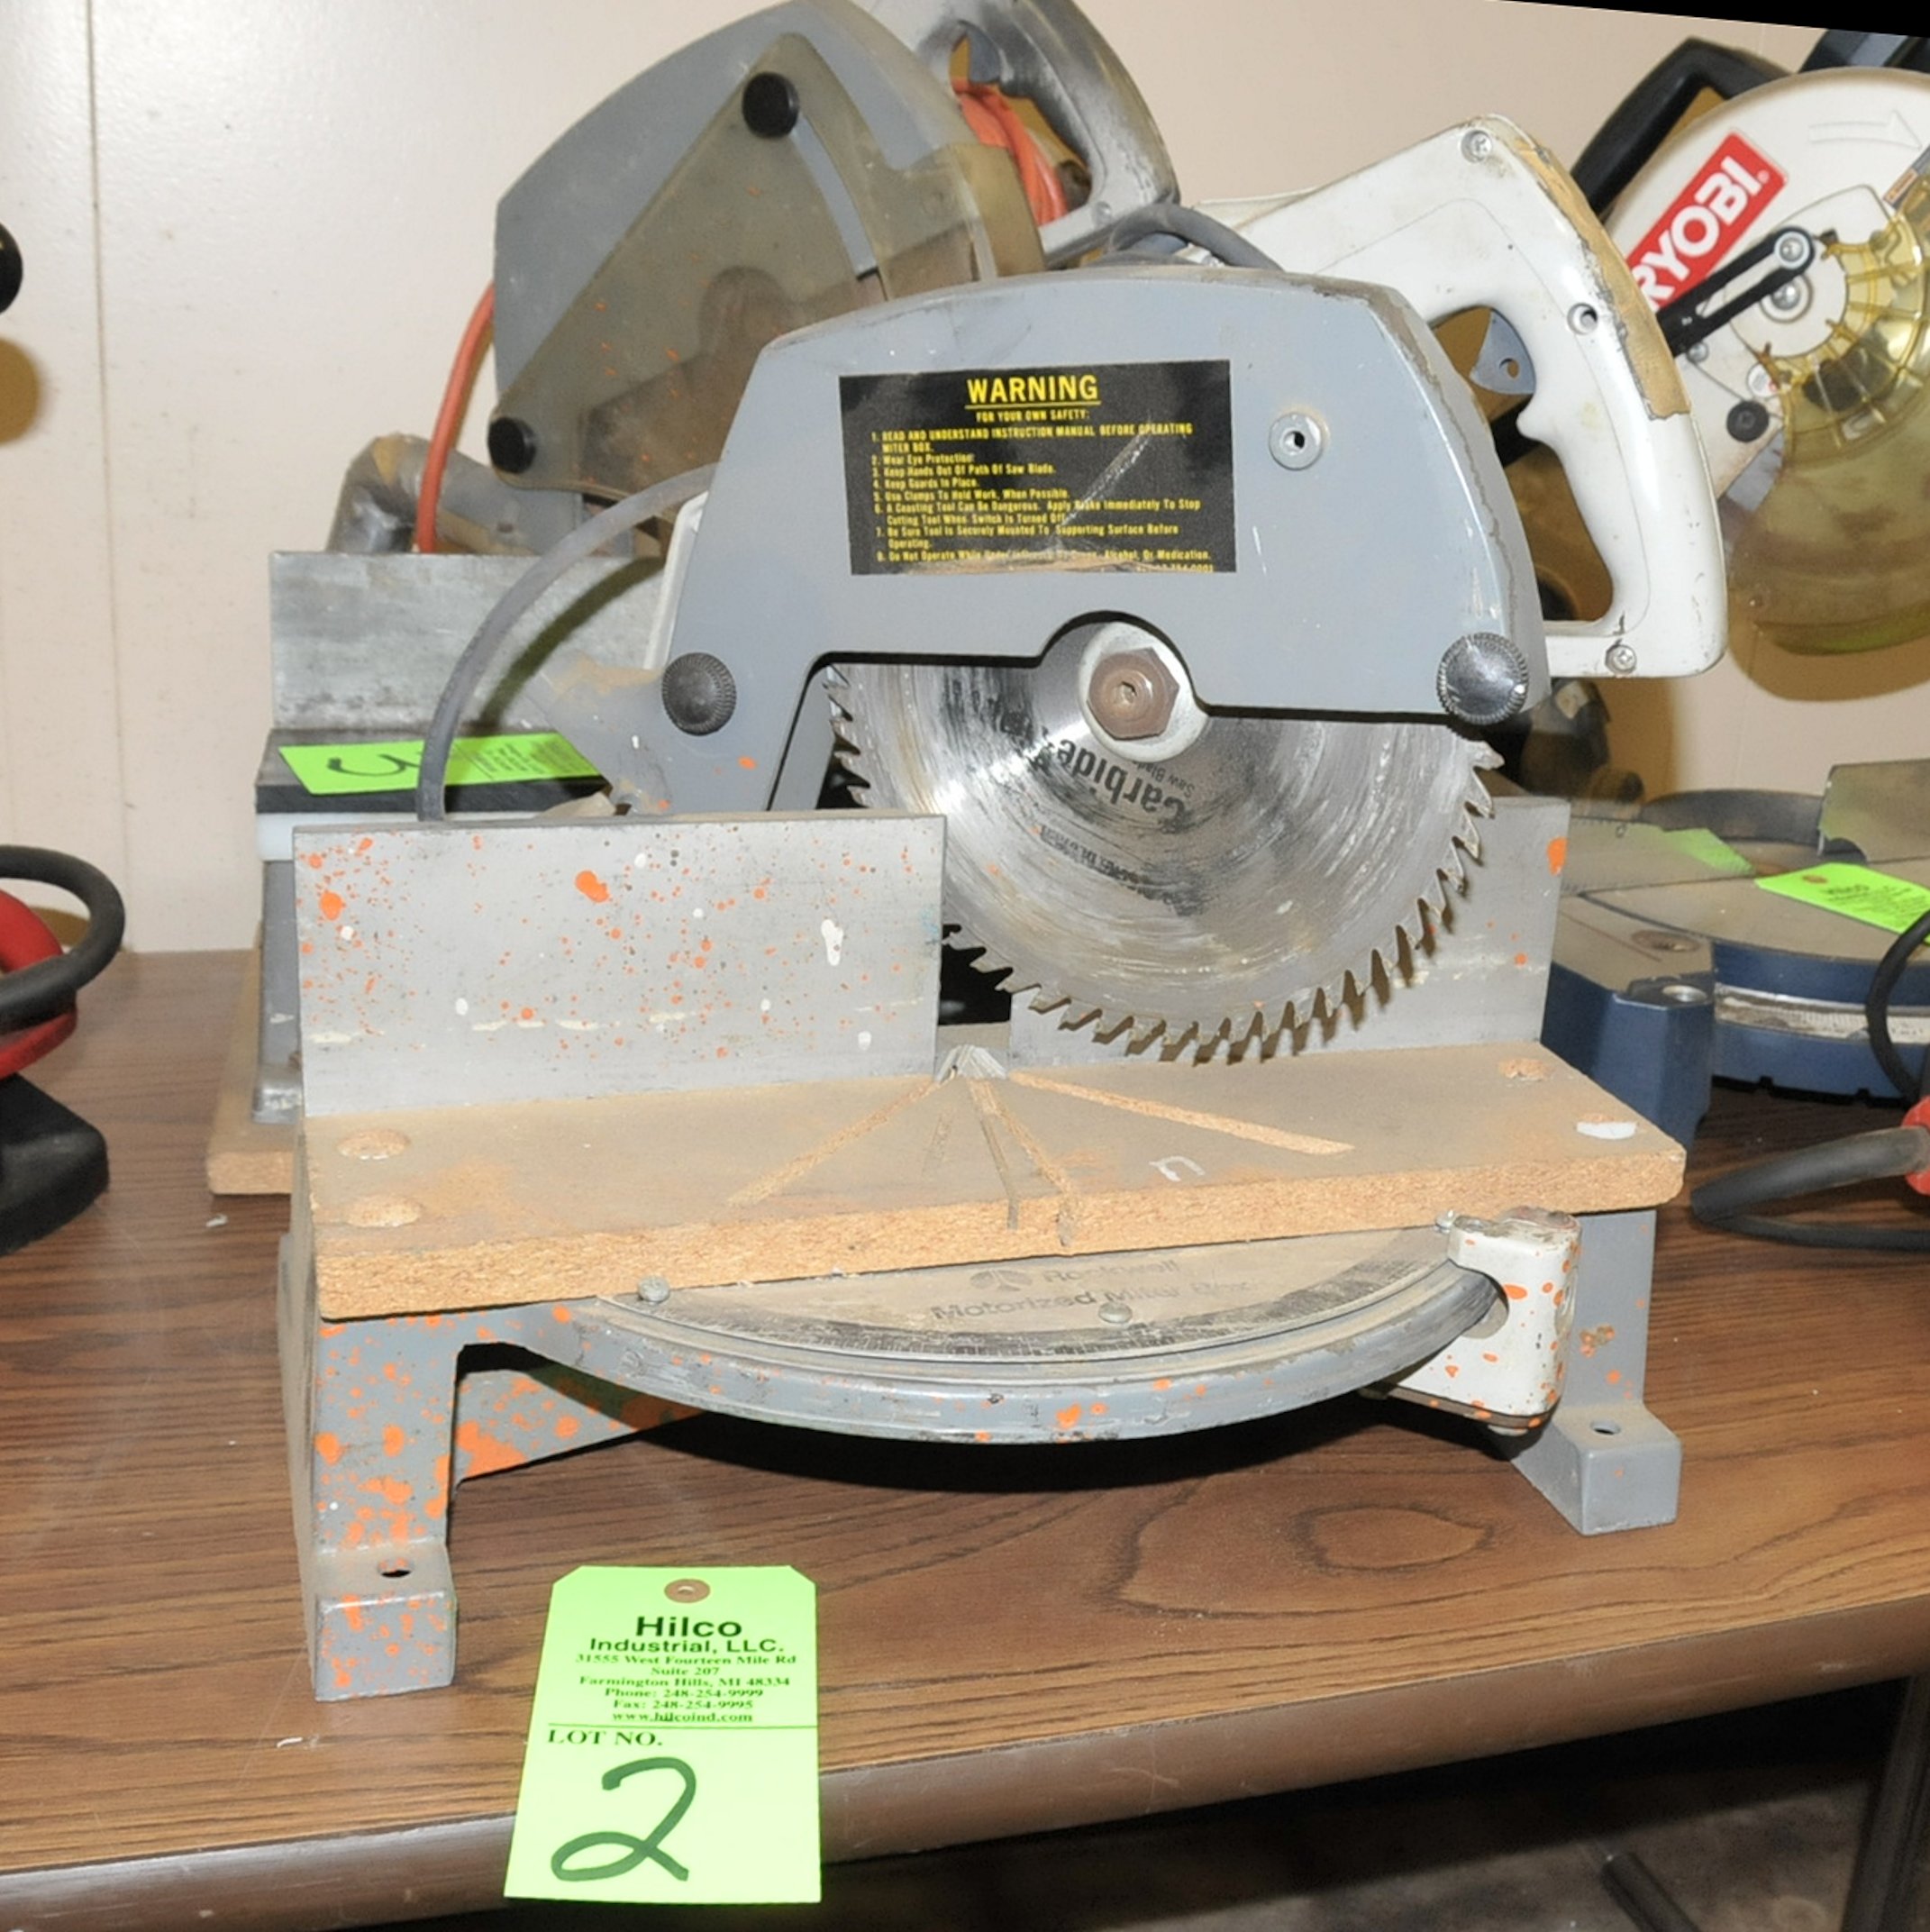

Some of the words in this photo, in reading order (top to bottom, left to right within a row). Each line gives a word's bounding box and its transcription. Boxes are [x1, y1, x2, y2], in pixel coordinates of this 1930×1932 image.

[967, 375, 1097, 403] WARNING
[976, 412, 994, 423] FOR
[997, 411, 1022, 422] YOUR
[1025, 410, 1047, 421] OWN
[882, 430, 906, 442] READ
[908, 430, 926, 441] AND
[929, 428, 989, 441] UNDERSTAND
[992, 425, 1053, 438] INSTRUCTION
[1055, 425, 1096, 436] MANUAL
[1099, 424, 1135, 436] BEFORE
[1138, 423, 1193, 434] OPERATING
[882, 442, 910, 453] MITER
[883, 454, 904, 465] Wear
[907, 454, 923, 466] Eye
[884, 466, 906, 478] Keep
[907, 466, 934, 476] Hands
[936, 465, 952, 475] Out
[954, 464, 966, 475] Of
[969, 464, 990, 475] Path
[992, 463, 1004, 474] Of
[1006, 463, 1024, 474] Saw
[885, 478, 906, 490] Keep
[908, 478, 938, 488] Guards
[940, 478, 950, 488] In
[886, 492, 901, 502] Use
[904, 491, 935, 502] Clamps
[938, 490, 949, 500] To
[951, 490, 972, 500] Hold
[1002, 489, 1027, 499] When
[887, 503, 893, 513] A
[896, 502, 933, 514] Coasting
[936, 502, 954, 512] Tool
[958, 502, 975, 512] Can
[977, 501, 988, 512] Be
[992, 501, 1040, 513] Dangerous.
[1047, 500, 1070, 511] Apply
[1104, 500, 1160, 511] Immediately
[1163, 499, 1175, 509] To
[1179, 499, 1201, 511] Stop
[887, 515, 918, 526] Cutting
[922, 515, 941, 524] Tool
[943, 515, 967, 524] When
[972, 514, 1002, 524] Switch
[1005, 514, 1014, 524] Is
[1016, 514, 1048, 524] Turned
[887, 527, 899, 536] Be
[902, 527, 921, 536] Sure
[924, 526, 942, 536] Tool
[944, 526, 954, 536] Is
[957, 525, 994, 536] Securely
[997, 525, 1034, 535] Mounted
[1039, 525, 1050, 535] To
[1056, 524, 1105, 536] Supporting
[1107, 524, 1143, 534] Surface
[1147, 524, 1179, 534] Before
[888, 551, 900, 561] Do
[903, 551, 918, 560] Not
[921, 550, 955, 561] Operate
[1143, 550, 1154, 560] Or
[1157, 549, 1212, 560] Medication.
[1057, 738, 1191, 826] Carbide
[1168, 775, 1196, 798] Saw
[1042, 1260, 1180, 1283] Rockwell
[930, 1291, 1097, 1320] Motorized
[636, 1616, 742, 1637] Hilco
[590, 1637, 717, 1654] Industrial,
[726, 1639, 784, 1653] LLC.
[576, 1654, 619, 1663] 31555
[625, 1655, 660, 1664] West
[665, 1655, 732, 1665] Fourteen
[736, 1655, 770, 1665] Mile
[775, 1654, 797, 1664] Rd
[651, 1666, 689, 1676] Suite
[694, 1667, 720, 1676] 207
[579, 1676, 669, 1688] Farmington
[674, 1677, 713, 1688] Hills,
[718, 1678, 740, 1687] MI
[746, 1677, 790, 1686] 48334
[605, 1688, 657, 1698] Phone:
[663, 1689, 763, 1698] 248-254-9999
[614, 1700, 646, 1709] Fax:
[652, 1700, 753, 1709] 248-254-9995
[613, 1712, 753, 1723] www.hilcoind.com
[547, 1729, 606, 1745] LOT
[615, 1729, 663, 1746] NO.
[551, 1755, 696, 1882] 2
